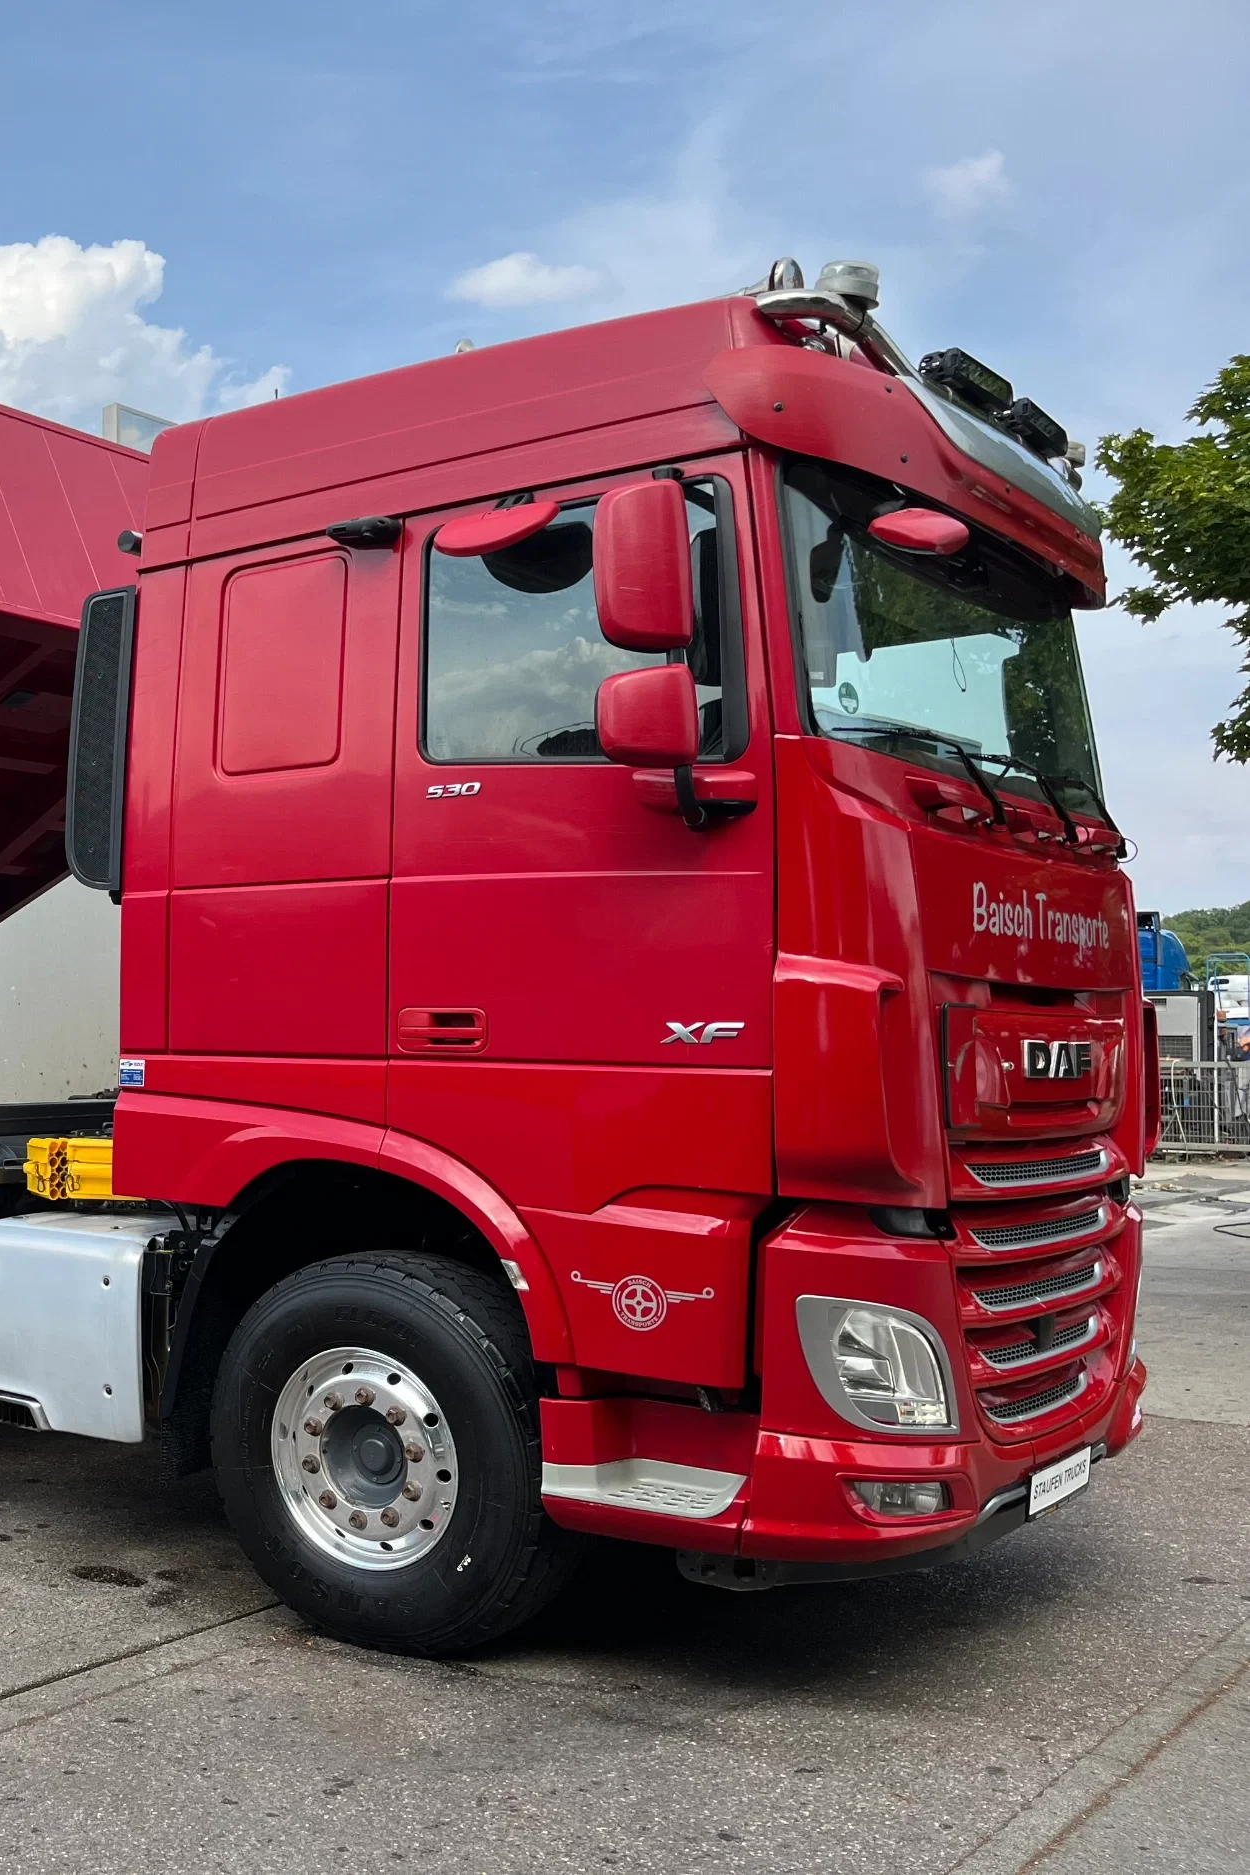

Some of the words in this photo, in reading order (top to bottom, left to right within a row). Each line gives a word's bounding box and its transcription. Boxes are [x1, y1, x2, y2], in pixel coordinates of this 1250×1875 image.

[425, 781, 481, 799] 530
[972, 881, 1033, 939] Baisch
[1035, 893, 1110, 962] Transporte
[659, 1021, 745, 1044] XF
[1020, 1039, 1092, 1079] DAF
[619, 1311, 660, 1328] TRANSPORTE
[1033, 1472, 1064, 1500] STAUFEN
[1064, 1459, 1087, 1485] TRUCKS
